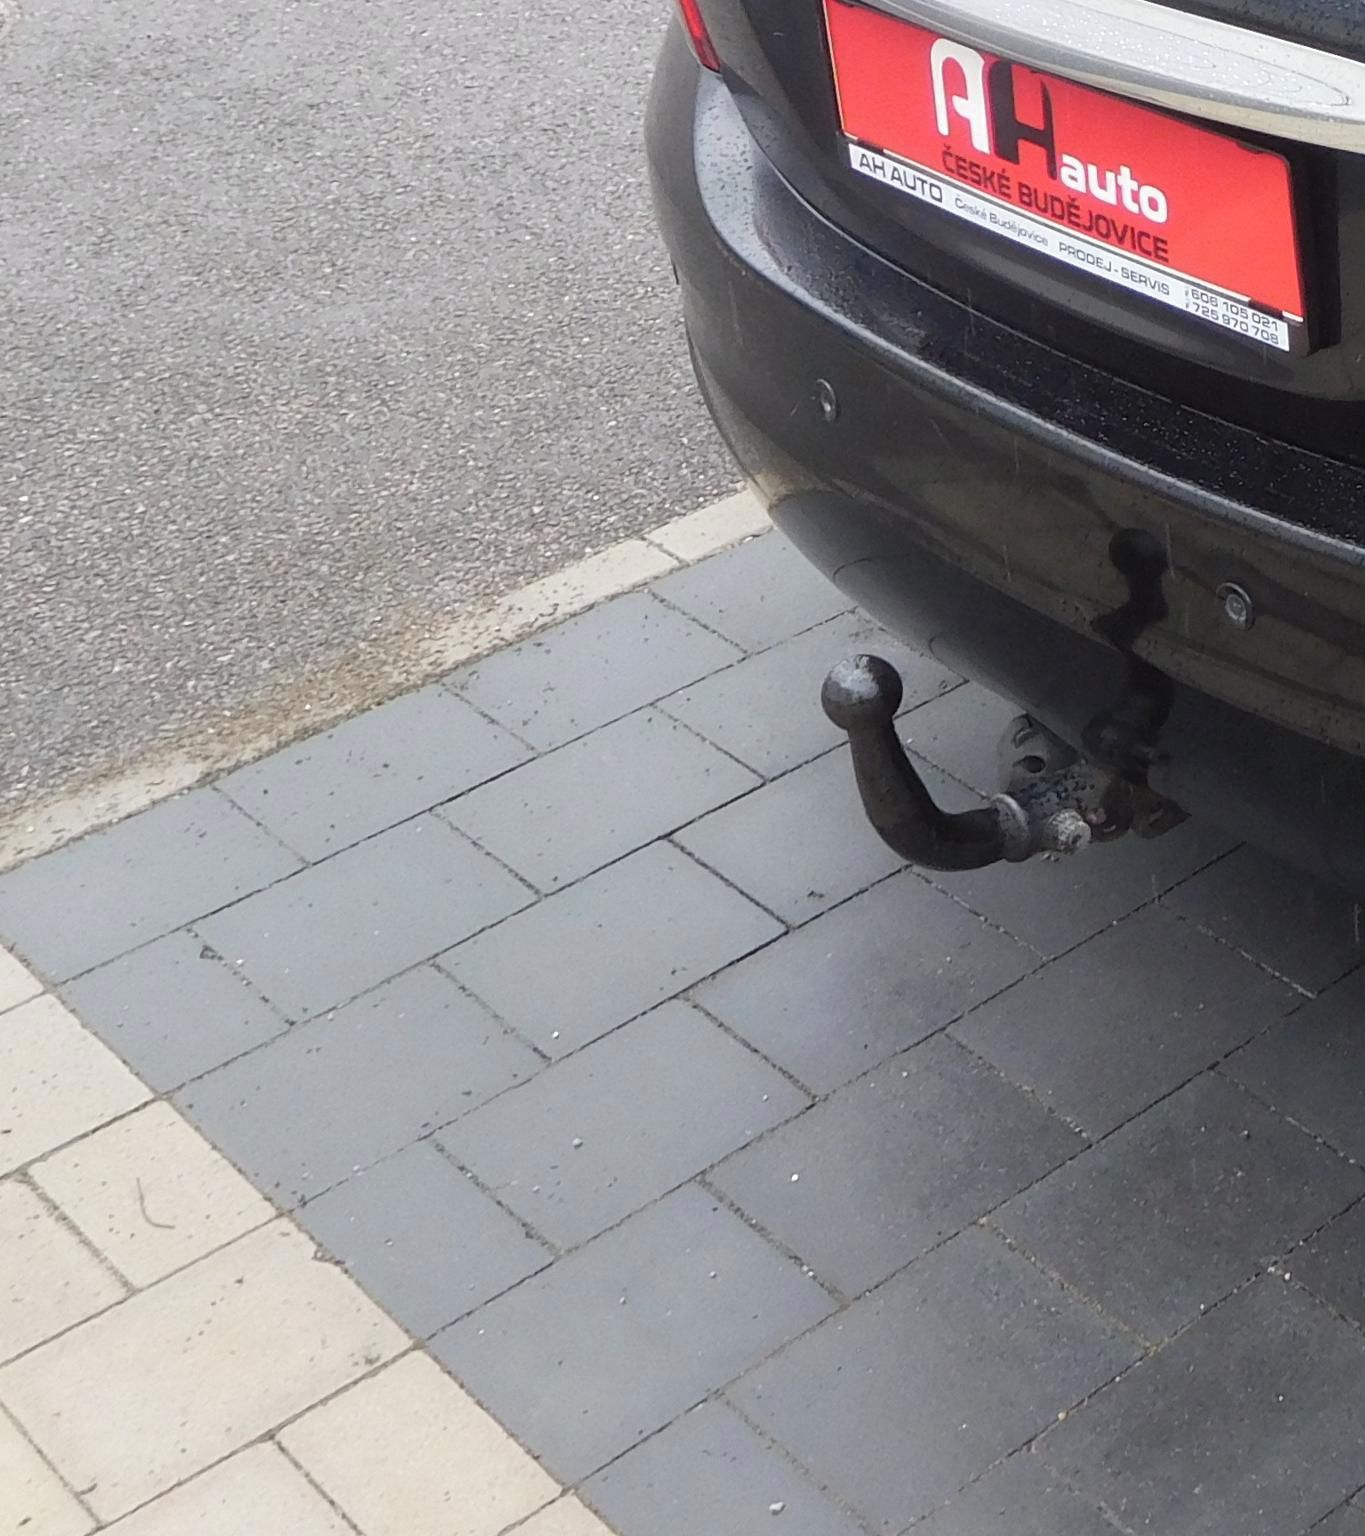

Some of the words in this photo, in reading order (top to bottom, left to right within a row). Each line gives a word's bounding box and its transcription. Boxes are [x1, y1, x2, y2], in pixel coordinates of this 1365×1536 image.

[942, 143, 1012, 201] ČESKÉ
[1018, 181, 1170, 263] BUDĚJOVICE
[1060, 153, 1169, 224] auto
[859, 153, 886, 178] AH
[890, 169, 943, 203] AUTO
[954, 193, 987, 221] České
[989, 213, 1049, 247] Budějovice
[1058, 241, 1112, 273] PRODEJ
[1121, 266, 1170, 296] SERVIS
[1193, 302, 1219, 321] 725
[1222, 314, 1248, 333] 970
[1252, 325, 1279, 345] 708
[1223, 301, 1249, 320] 105
[1252, 312, 1279, 332] 021
